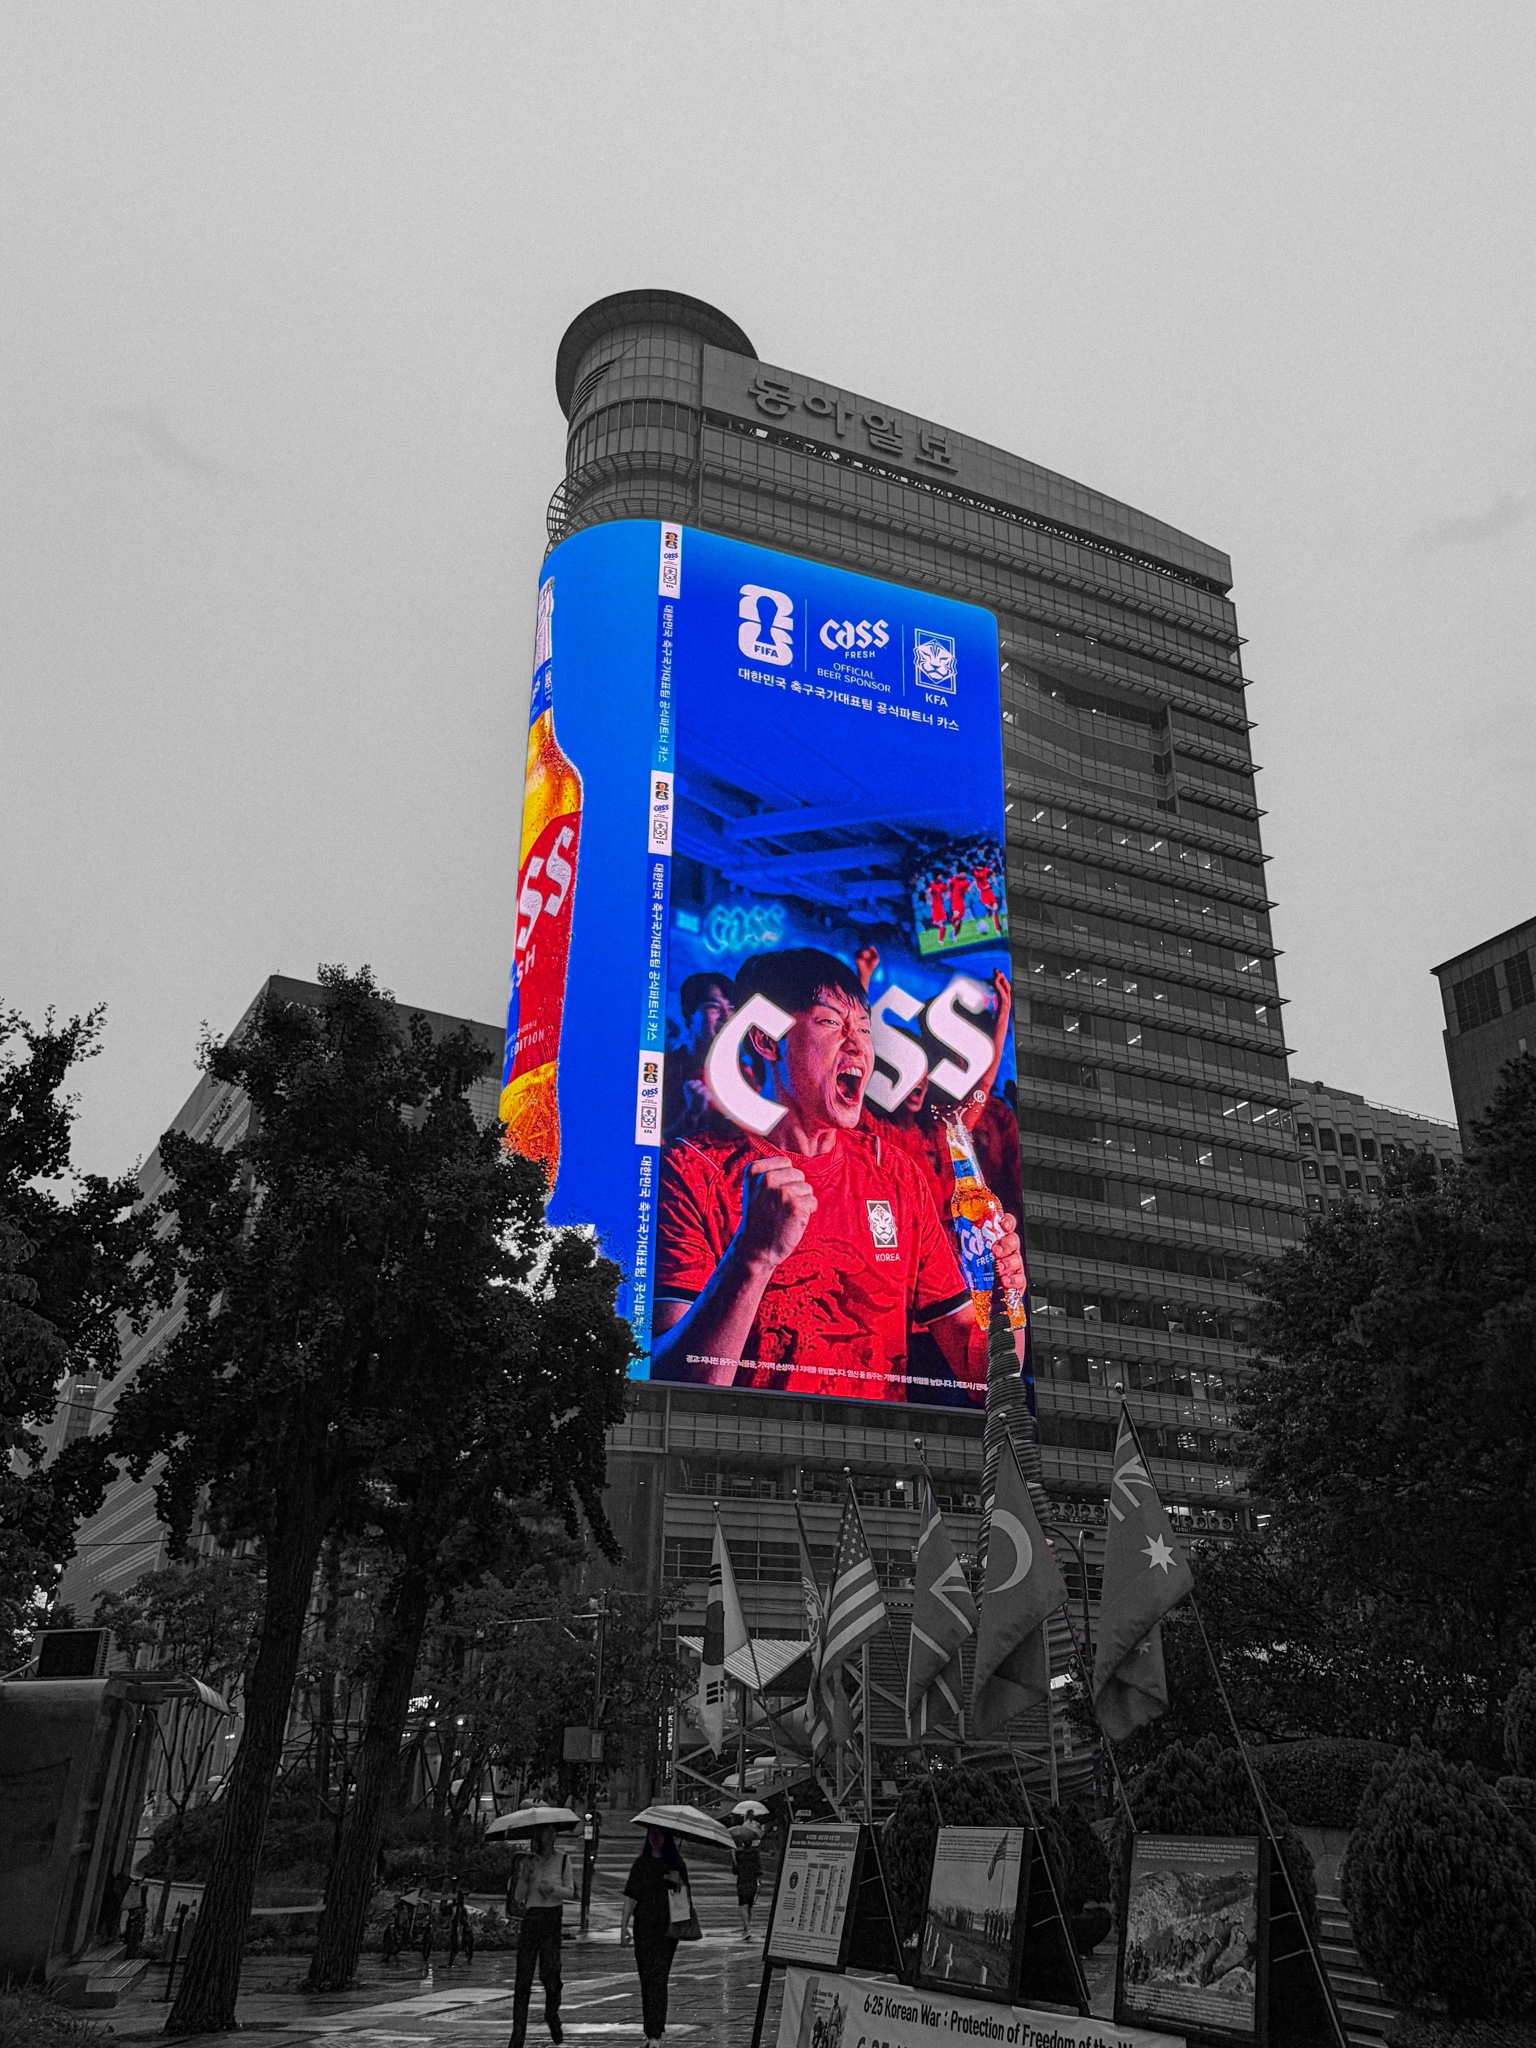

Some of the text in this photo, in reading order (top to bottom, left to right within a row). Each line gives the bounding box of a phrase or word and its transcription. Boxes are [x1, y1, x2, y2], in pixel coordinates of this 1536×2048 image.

[748, 374, 959, 474] 동아일보
[662, 604, 674, 638] 대한민국
[754, 644, 779, 659] FIFA
[844, 650, 876, 660] FRESH
[817, 667, 891, 693] BEER SPONSOR
[833, 662, 876, 680] OFFICIAL
[738, 667, 960, 731] 대한민국 축구국가대표팀 공식파트너 카스
[925, 692, 949, 708] KFA
[658, 700, 670, 744] 공식파트너
[652, 863, 665, 899] 대한민국
[648, 971, 661, 1019] 공식파트너
[646, 1020, 658, 1042] 카스
[638, 1155, 653, 1199] 대한민국
[875, 1253, 901, 1262] KOREA
[976, 1252, 996, 1268] FRES
[884, 1997, 918, 2023] Korean
[921, 2004, 942, 2028] War
[950, 2010, 1005, 2041] Protection
[1006, 2025, 1021, 2046] of
[1022, 2023, 1076, 2048] Freedom
